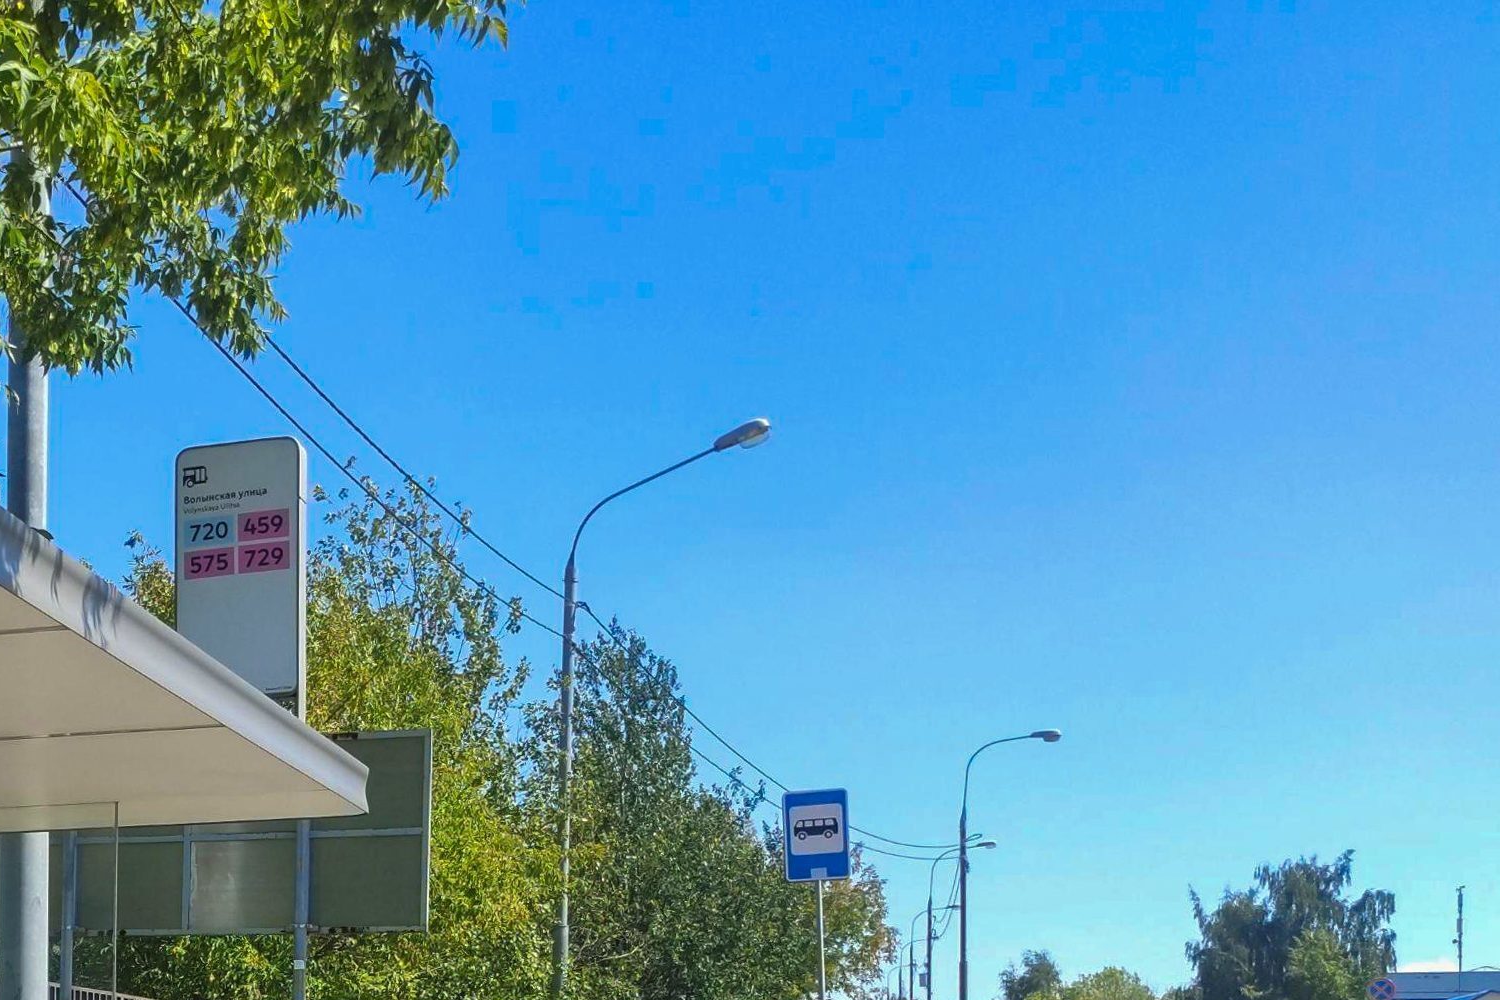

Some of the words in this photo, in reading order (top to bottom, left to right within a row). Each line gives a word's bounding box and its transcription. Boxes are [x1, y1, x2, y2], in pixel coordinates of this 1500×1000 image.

[190, 521, 228, 542] 720
[244, 515, 283, 535] 459
[190, 553, 229, 574] 575
[244, 547, 283, 568] 729
